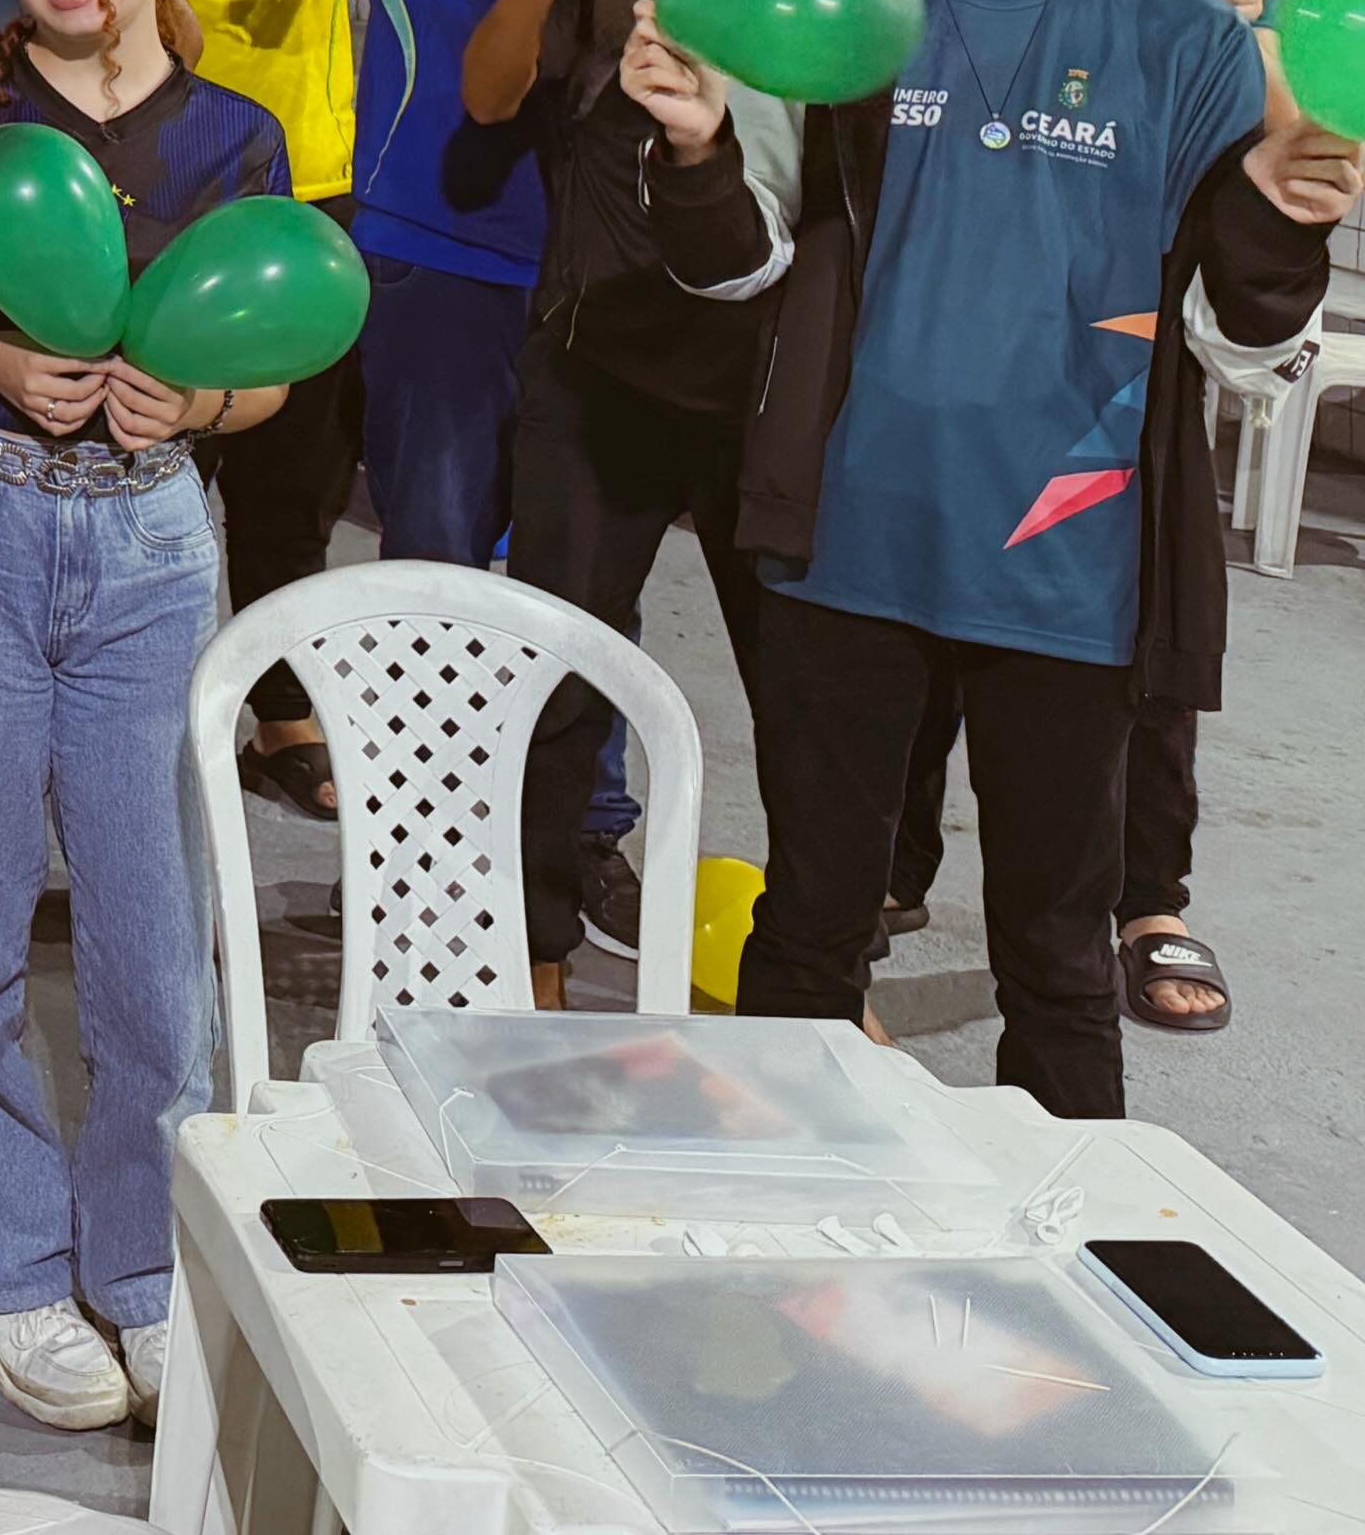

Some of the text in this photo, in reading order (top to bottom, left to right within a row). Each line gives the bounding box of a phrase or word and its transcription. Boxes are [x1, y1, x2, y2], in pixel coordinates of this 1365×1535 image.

[893, 87, 949, 104] IMEIRO
[890, 104, 942, 127] SSO
[1021, 110, 1117, 151] CEARÁ
[1060, 141, 1076, 151] DO
[1077, 144, 1116, 160] ESTADO
[1160, 943, 1201, 961] NIKE
